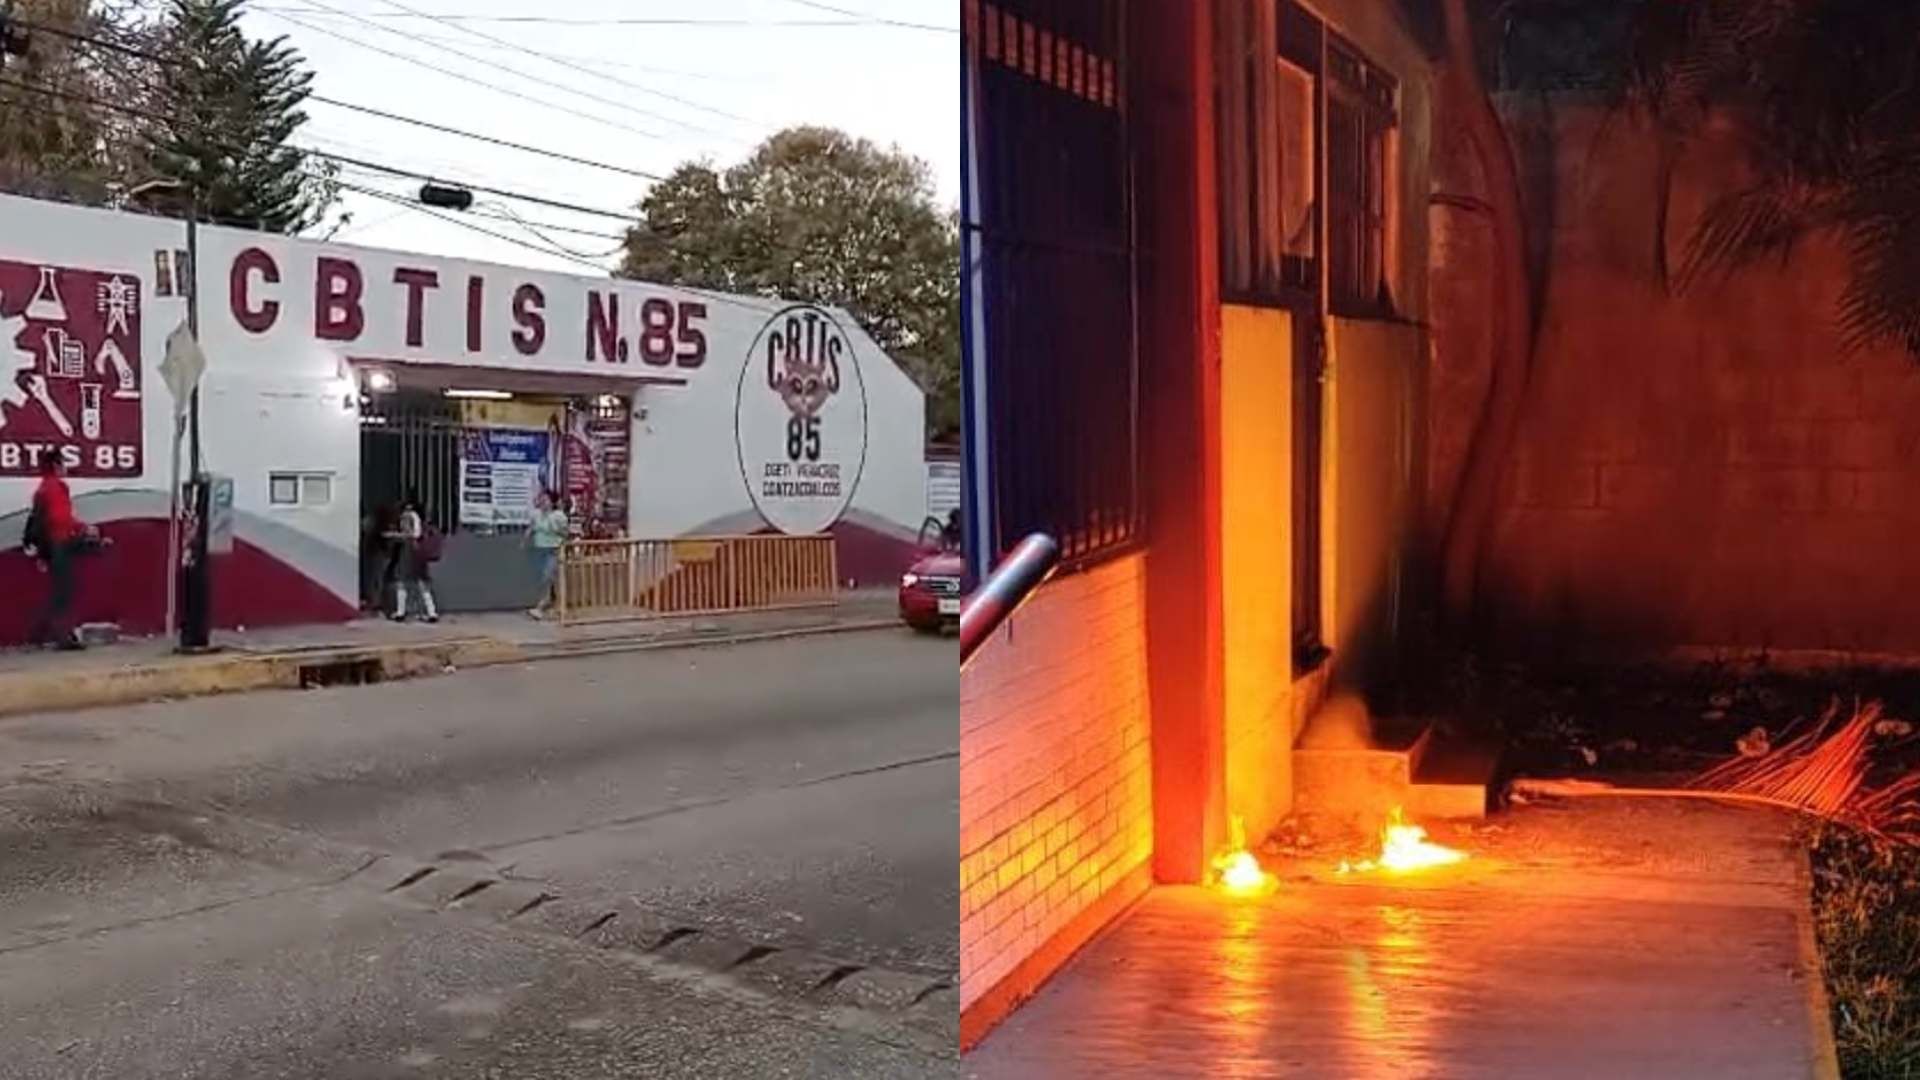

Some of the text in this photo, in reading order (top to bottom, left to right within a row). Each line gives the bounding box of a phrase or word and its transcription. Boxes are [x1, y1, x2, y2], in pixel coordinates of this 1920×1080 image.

[768, 312, 842, 394] CBTIS
[95, 445, 136, 470] 85
[787, 415, 822, 462] 85
